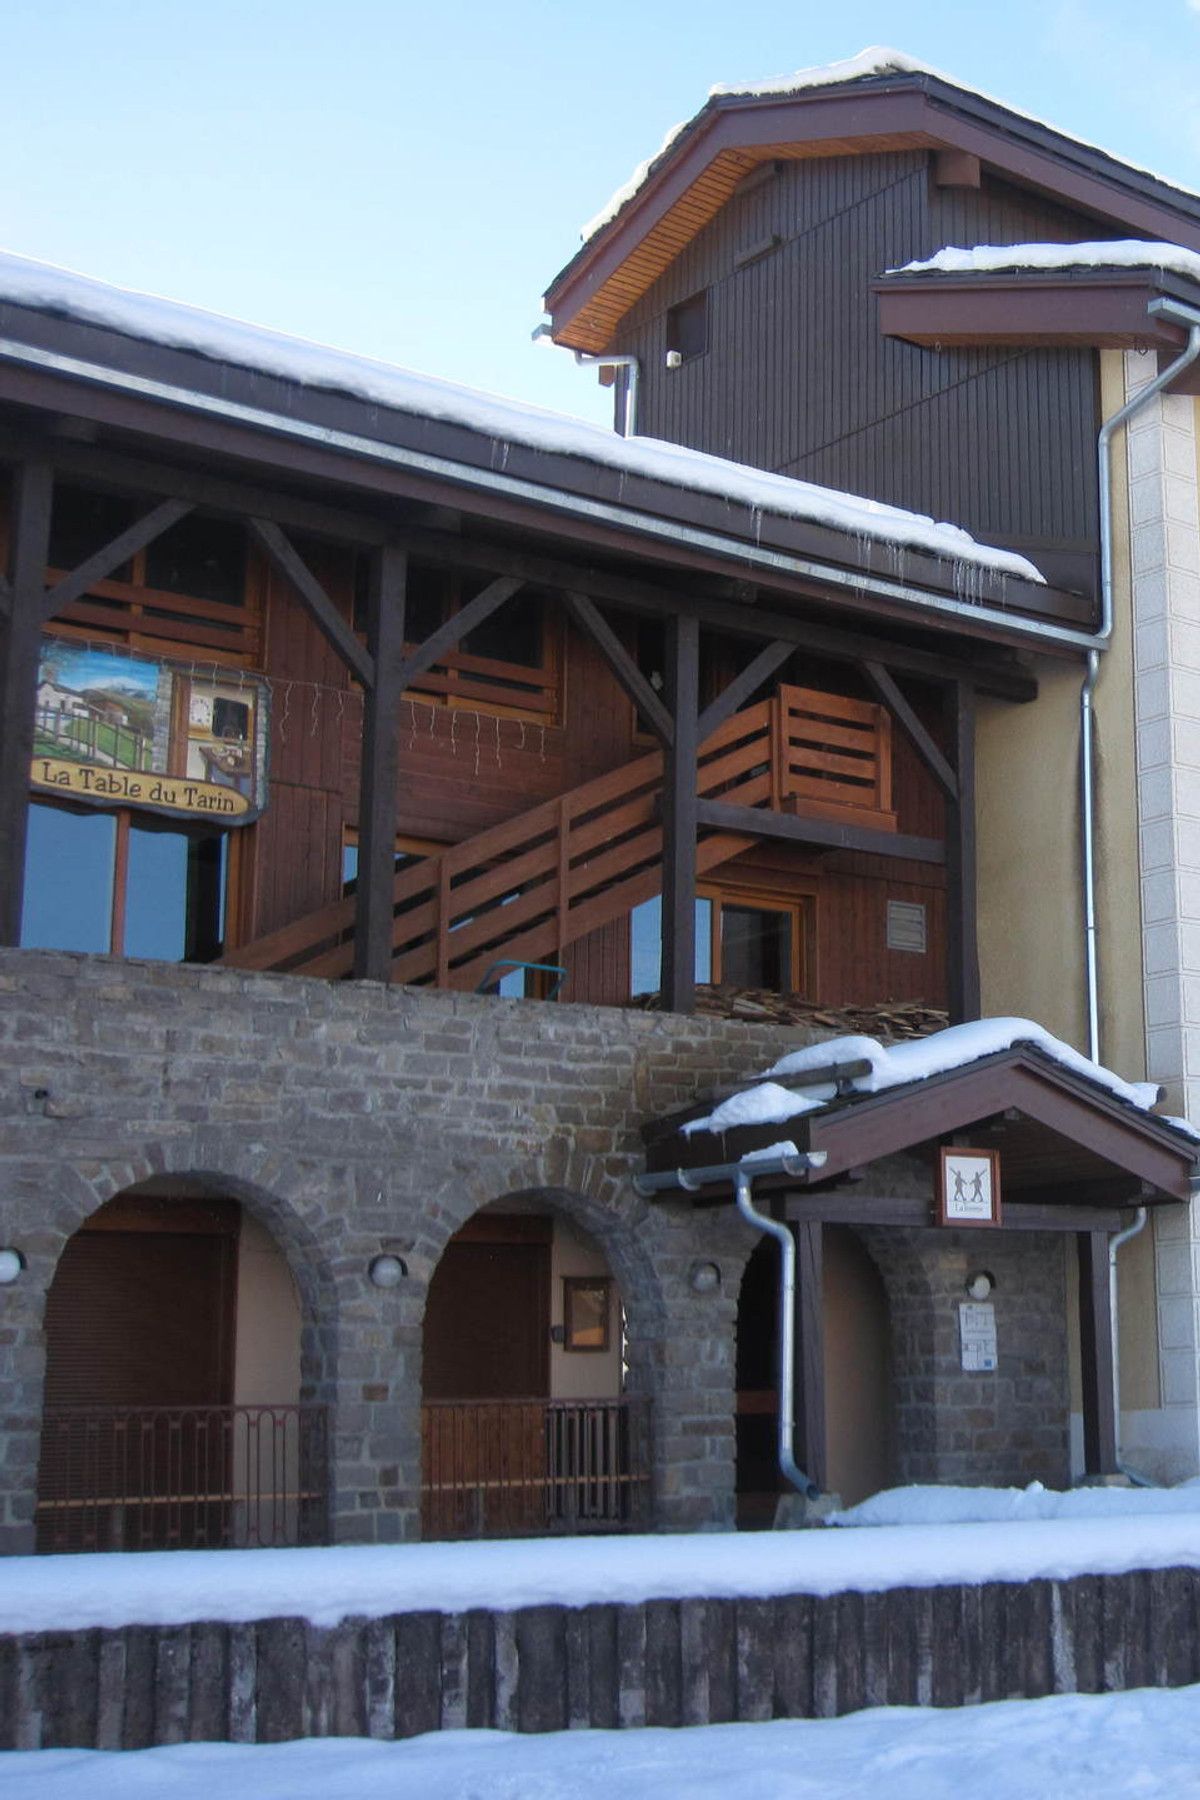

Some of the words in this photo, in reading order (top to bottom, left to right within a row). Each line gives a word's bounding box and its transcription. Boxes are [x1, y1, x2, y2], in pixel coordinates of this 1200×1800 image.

[43, 761, 71, 786] La
[79, 768, 142, 798] Table
[149, 782, 176, 804] du
[184, 787, 235, 812] Tarin
